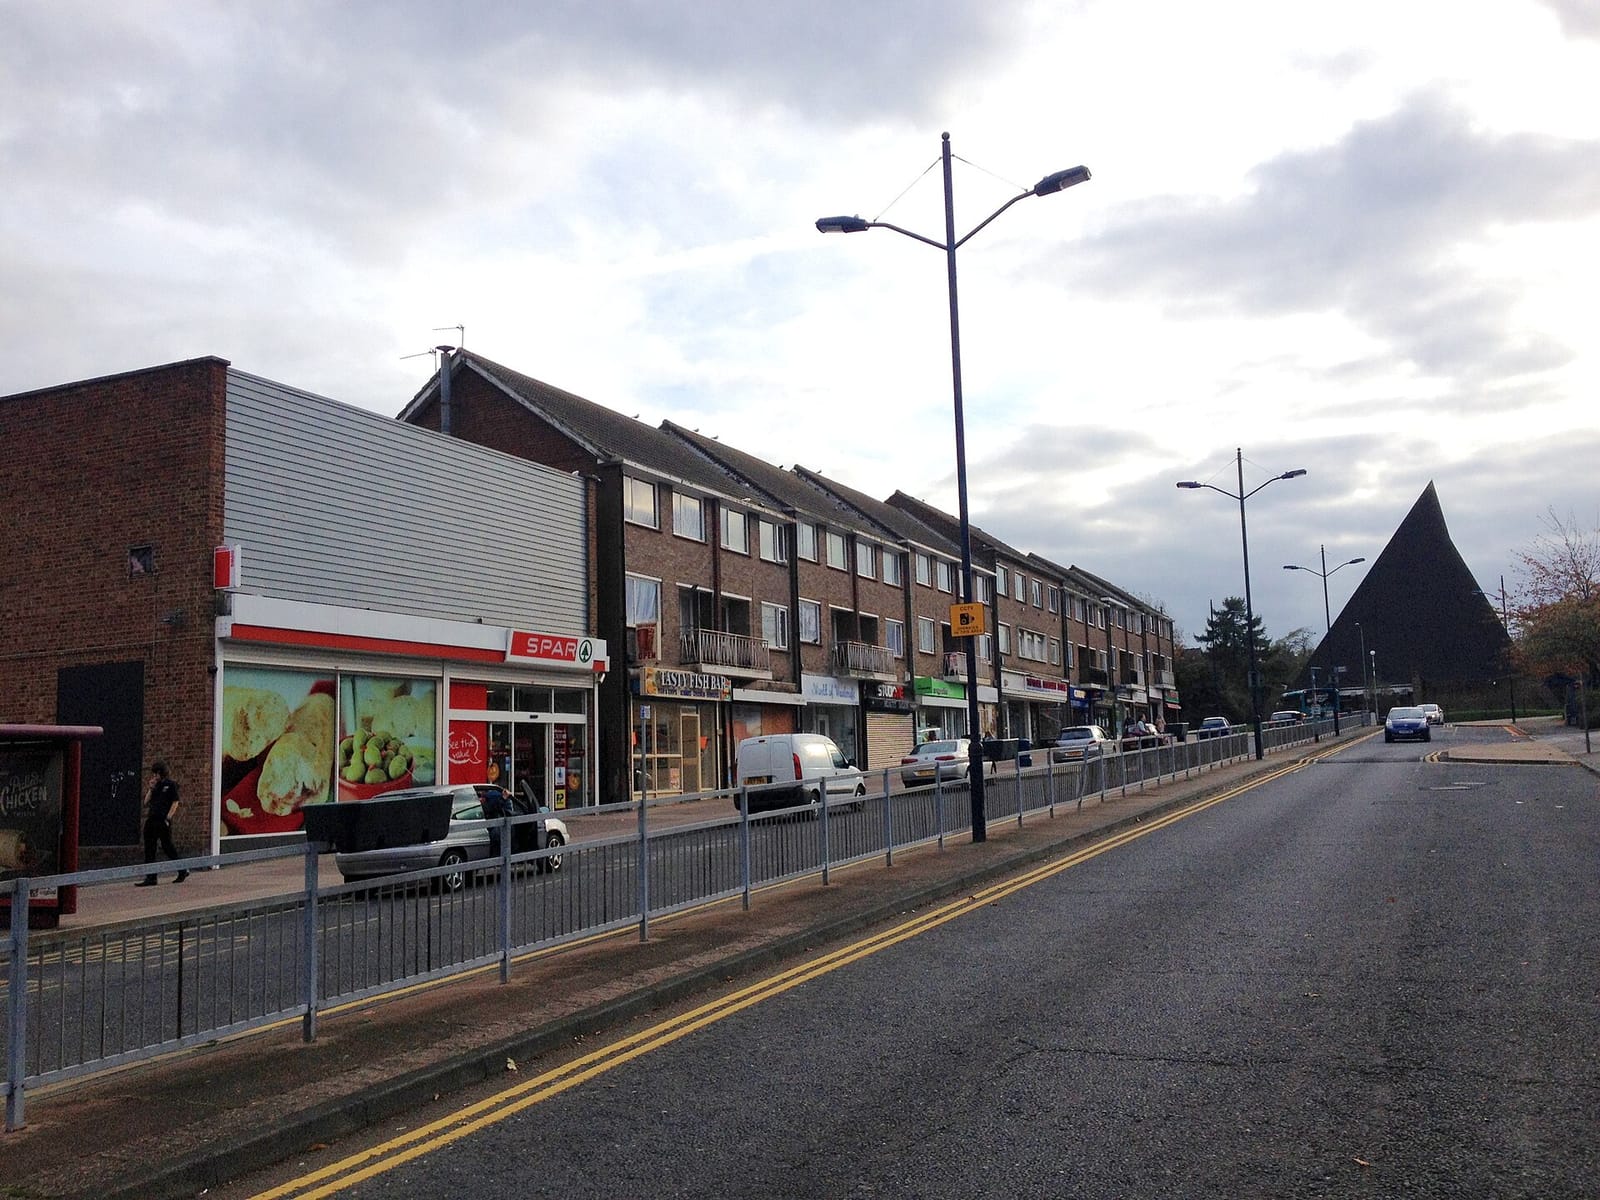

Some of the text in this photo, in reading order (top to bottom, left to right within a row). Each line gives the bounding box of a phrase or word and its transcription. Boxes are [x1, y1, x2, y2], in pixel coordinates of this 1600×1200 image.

[527, 637, 577, 658] SPAR
[660, 671, 727, 690] TASTY FISH BAR
[461, 738, 475, 748] the
[0, 786, 48, 816] CHICKEN
